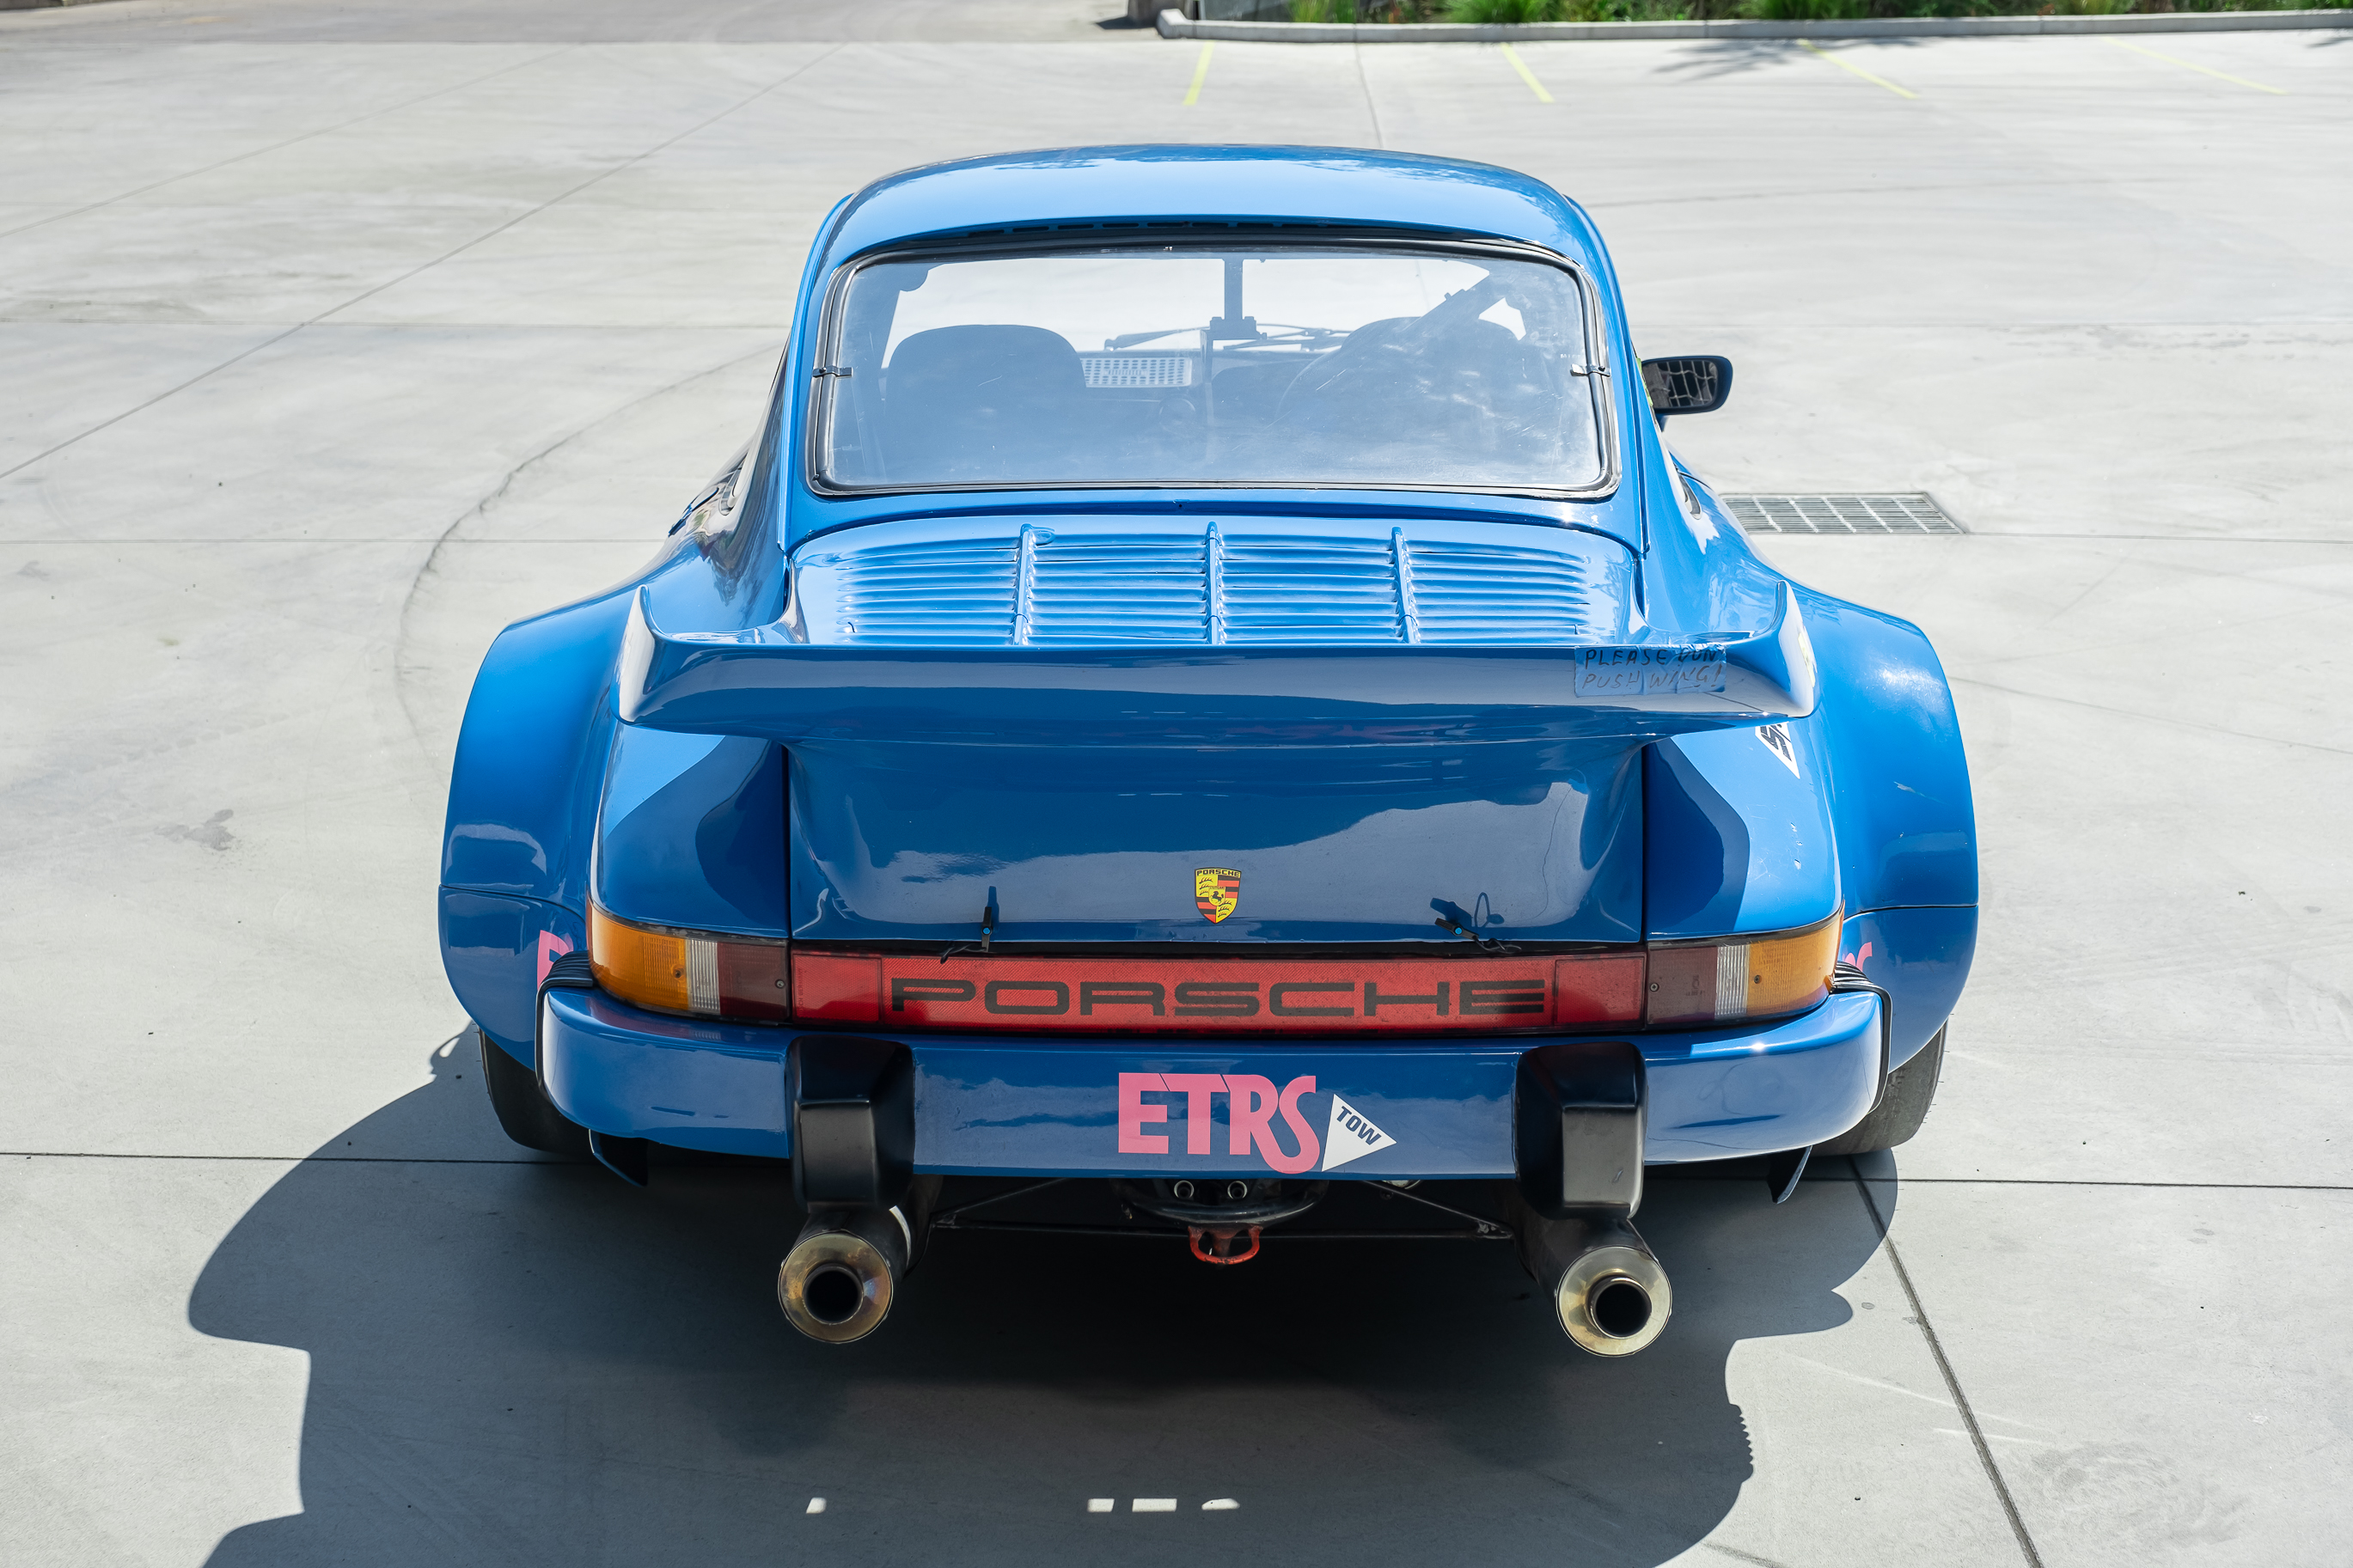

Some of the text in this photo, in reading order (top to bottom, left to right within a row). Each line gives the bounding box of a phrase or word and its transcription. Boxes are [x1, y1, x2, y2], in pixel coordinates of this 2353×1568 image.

[1585, 648, 1668, 670] PLEASE
[1581, 670, 1641, 690] PUSH
[1196, 869, 1240, 878] PORSCHE
[890, 977, 1546, 1017] PORSCHE
[1118, 1071, 1321, 1174] ETRS
[1335, 1105, 1383, 1147] TOW
